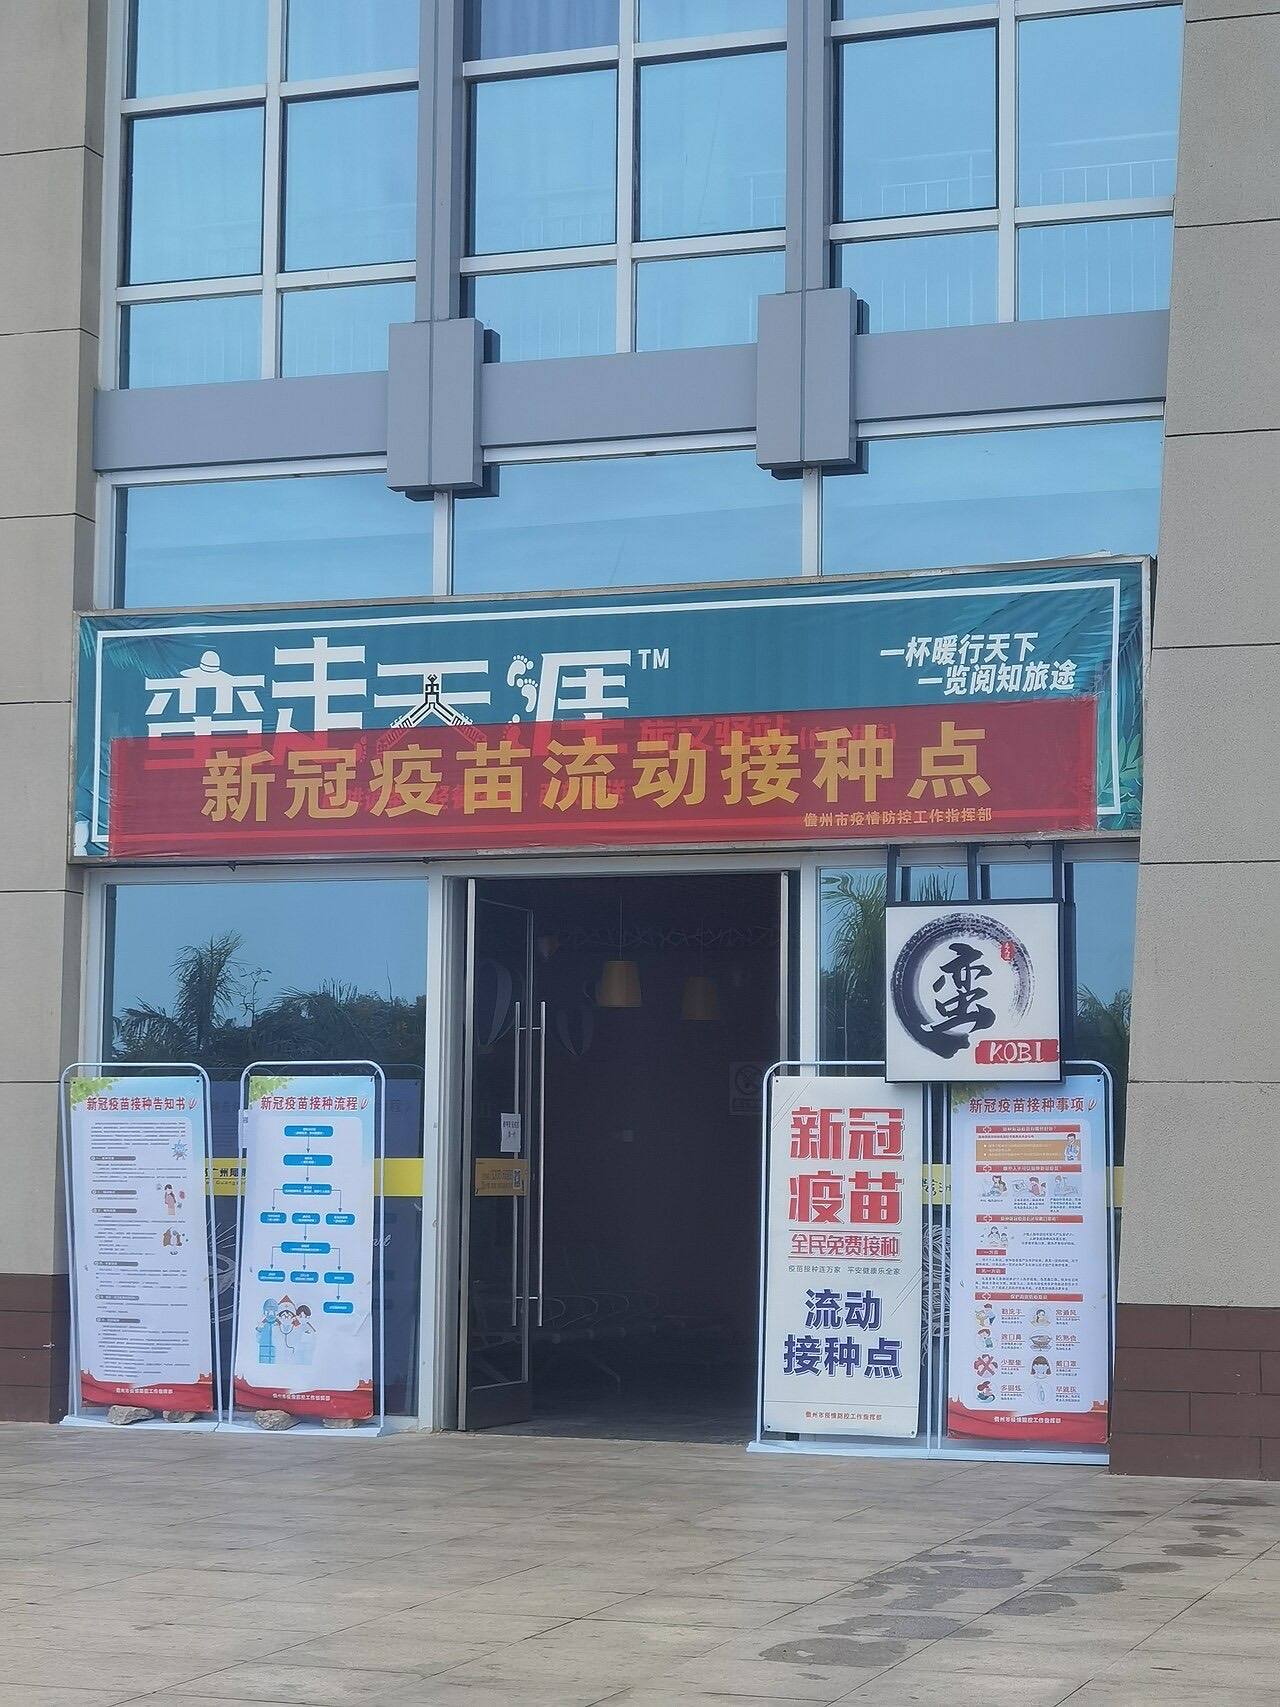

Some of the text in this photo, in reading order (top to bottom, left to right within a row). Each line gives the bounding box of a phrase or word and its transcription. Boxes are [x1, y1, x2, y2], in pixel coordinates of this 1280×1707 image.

[638, 648, 670, 670] TM
[880, 632, 1039, 668] 一杯暖行天下
[918, 659, 1078, 696] 一览阅知旅途
[200, 720, 992, 823] 新冠疫苗流动接种点
[803, 807, 993, 827] 儋州市疫情防控工作指挥部
[989, 1041, 1045, 1063] KOBI
[86, 1096, 185, 1111] 新冠疫苗接种告知书
[260, 1096, 358, 1110] 新冠疫苗接种流程
[969, 1097, 1084, 1113] 新冠疫苗接种事项
[789, 1106, 905, 1160] 新冠
[788, 1170, 904, 1224] 疫苗
[791, 1233, 900, 1257] 全民免费接种
[804, 1288, 883, 1331] 流动
[783, 1334, 903, 1380] 接种点
